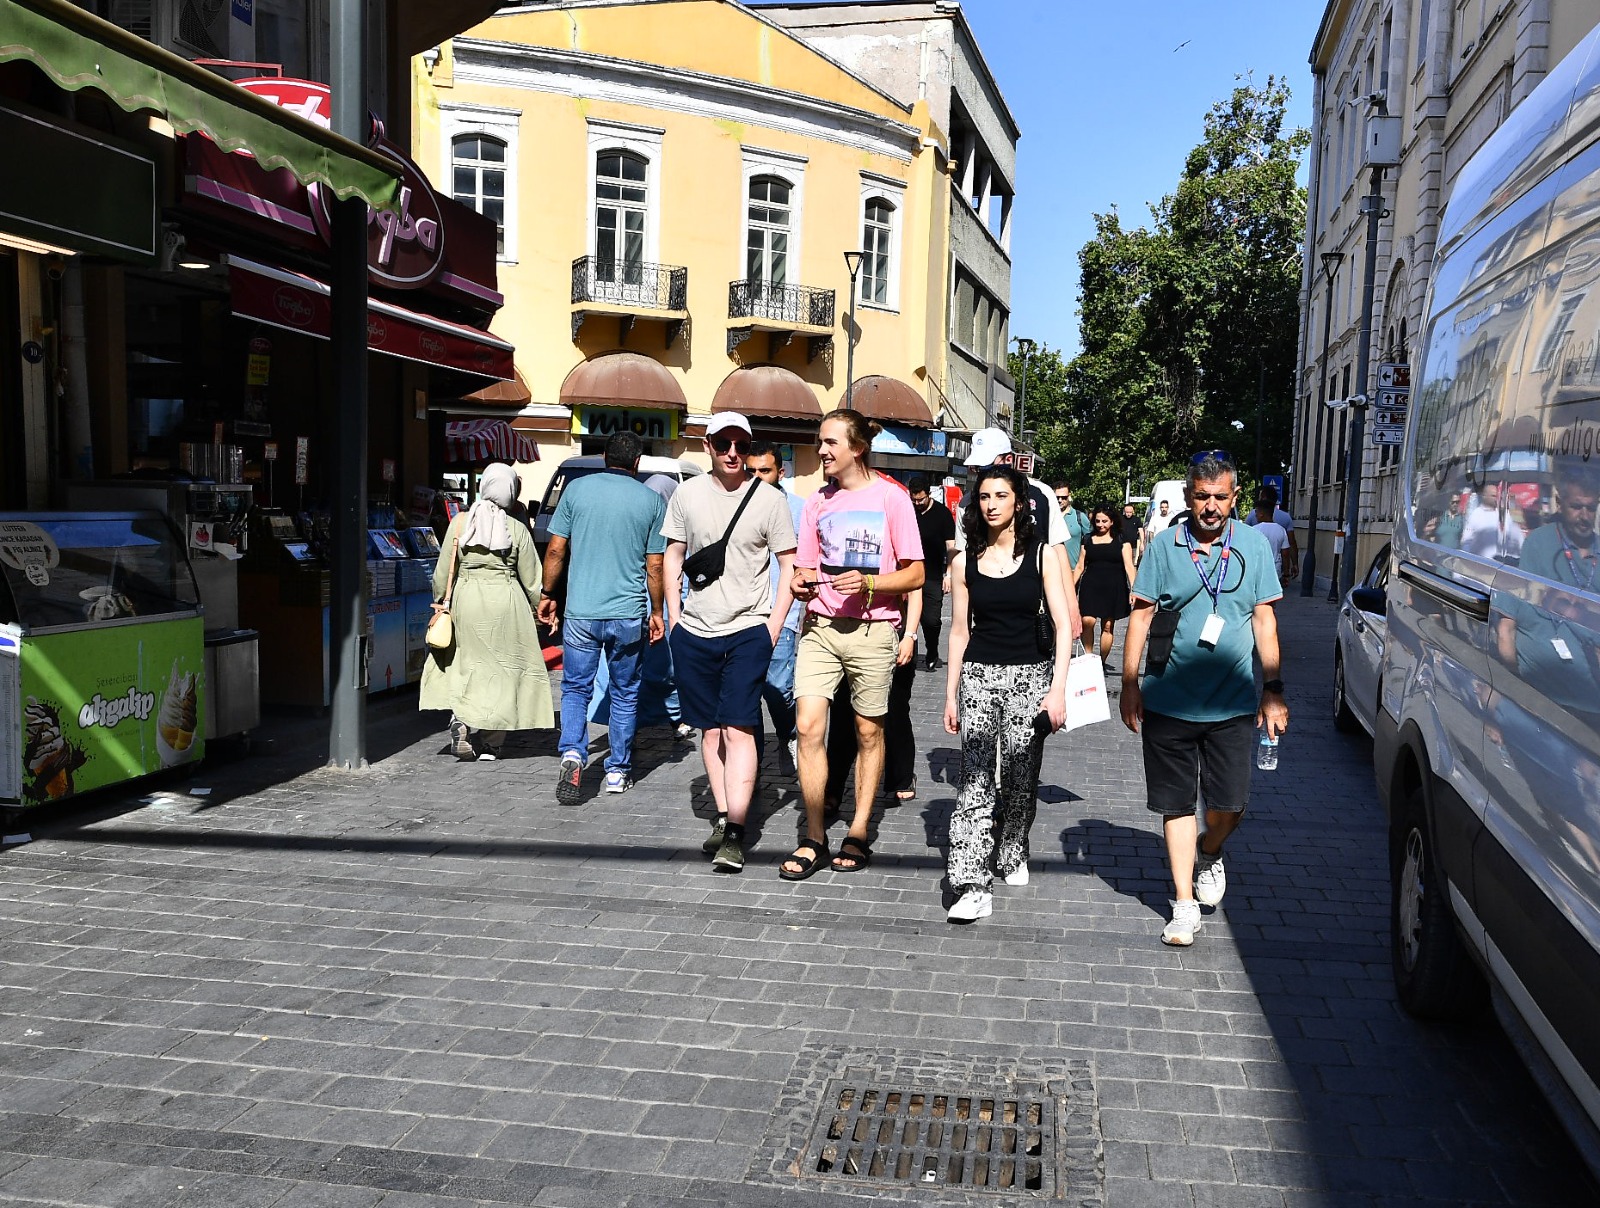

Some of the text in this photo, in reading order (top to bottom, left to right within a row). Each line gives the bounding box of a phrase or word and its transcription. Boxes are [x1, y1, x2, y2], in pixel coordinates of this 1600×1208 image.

[588, 409, 665, 438] mion
[1019, 457, 1030, 470] E
[78, 685, 155, 729] aligalip
